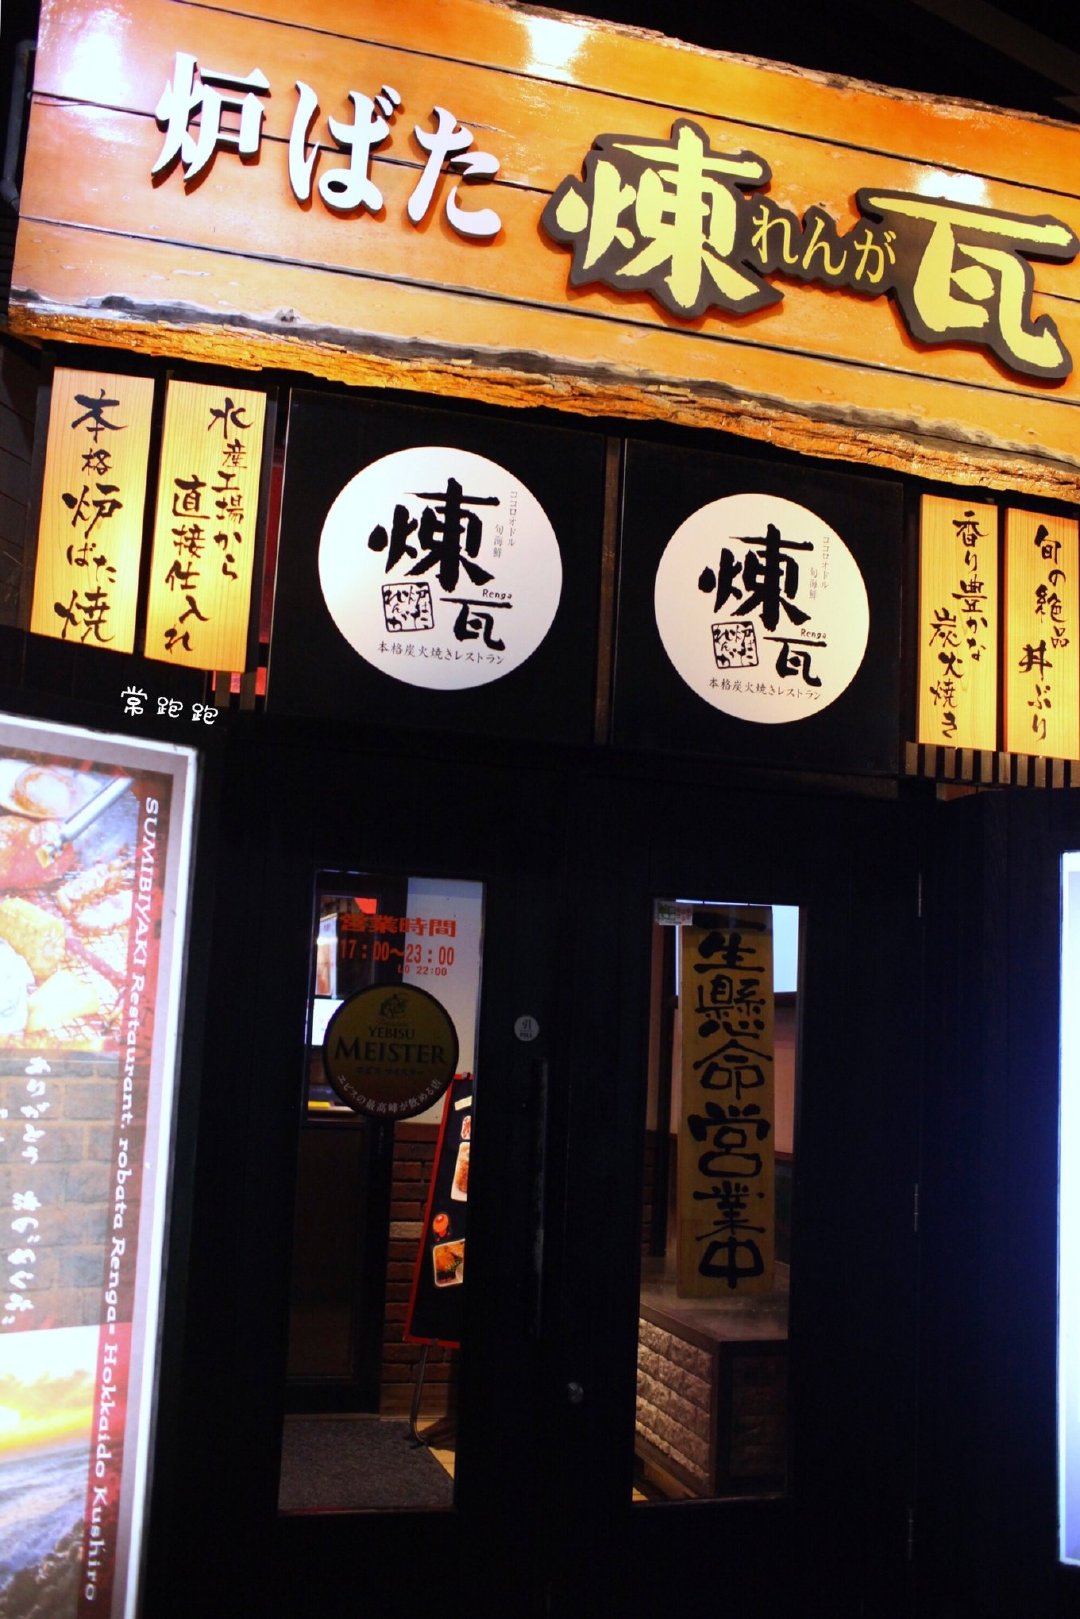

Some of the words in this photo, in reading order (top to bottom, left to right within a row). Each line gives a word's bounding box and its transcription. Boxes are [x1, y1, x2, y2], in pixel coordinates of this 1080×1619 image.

[151, 51, 501, 238] 炉ばた
[752, 204, 896, 284] れんが
[53, 388, 128, 643] 本格炉ばた焼
[207, 397, 254, 581] 水産工場から
[164, 474, 211, 655] 直接仕入れ
[482, 588, 513, 600] Renga
[952, 510, 988, 662] 香り豊かな
[1033, 524, 1070, 649] 旬の絶品
[378, 640, 504, 665] 本格炭火焼きレストラン
[800, 628, 827, 640] Renga
[929, 607, 963, 738] 炭火焼き
[709, 677, 821, 700] 本格炭火焼きレストラン
[1018, 640, 1053, 741] 丼ぶり
[133, 796, 159, 966] SUMIBIYAKI
[340, 914, 457, 938] 営業時間
[416, 966, 448, 977] 22:00
[119, 971, 145, 1130] Restaurant.
[334, 1035, 448, 1066] MEISTER
[367, 1026, 416, 1040] YEBISU
[112, 1137, 132, 1229] robata
[95, 1343, 118, 1478] Hokkaido
[84, 1486, 108, 1601] Kushiro
